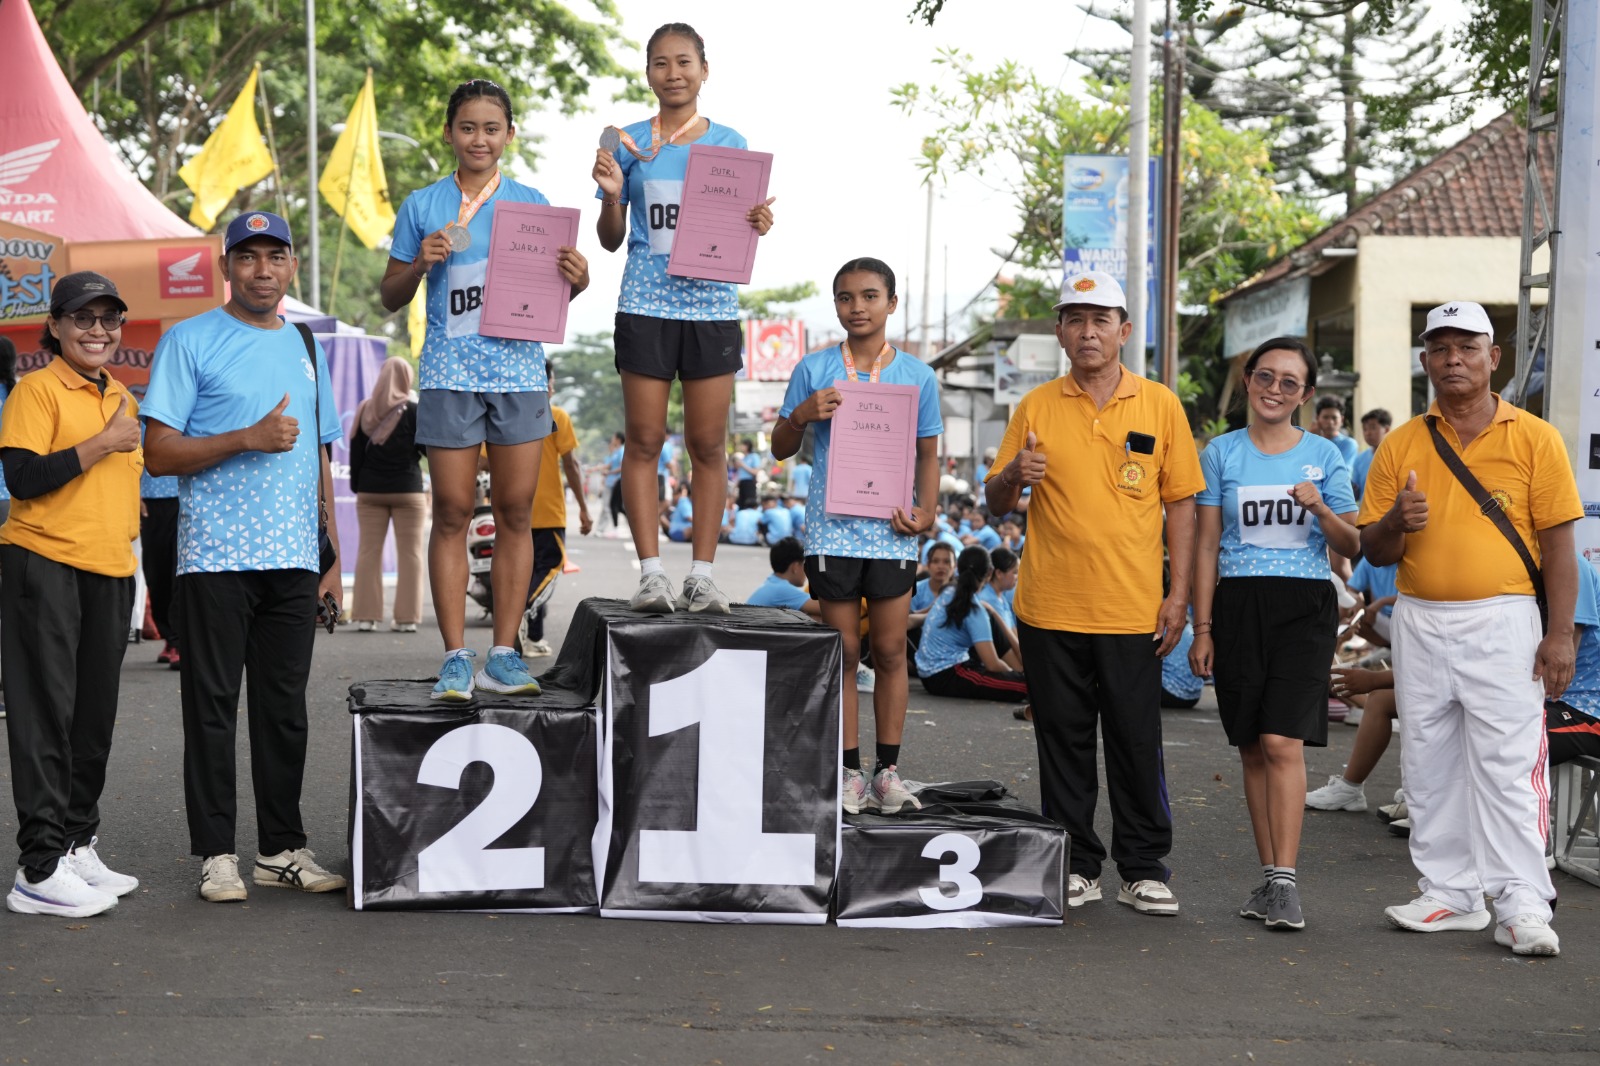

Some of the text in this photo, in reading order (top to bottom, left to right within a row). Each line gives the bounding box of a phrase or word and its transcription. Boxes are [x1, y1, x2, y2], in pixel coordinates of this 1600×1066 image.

[711, 166, 735, 177] PUTRI
[701, 184, 731, 195] JUARA
[521, 223, 545, 234] PUTRI
[509, 241, 546, 254] JUARA 2
[859, 401, 884, 411] PUTRI
[851, 421, 891, 432] JUARA 3
[1242, 499, 1307, 526] 0707
[637, 648, 816, 886] 1
[417, 723, 545, 893] 2
[917, 833, 983, 911] 3
